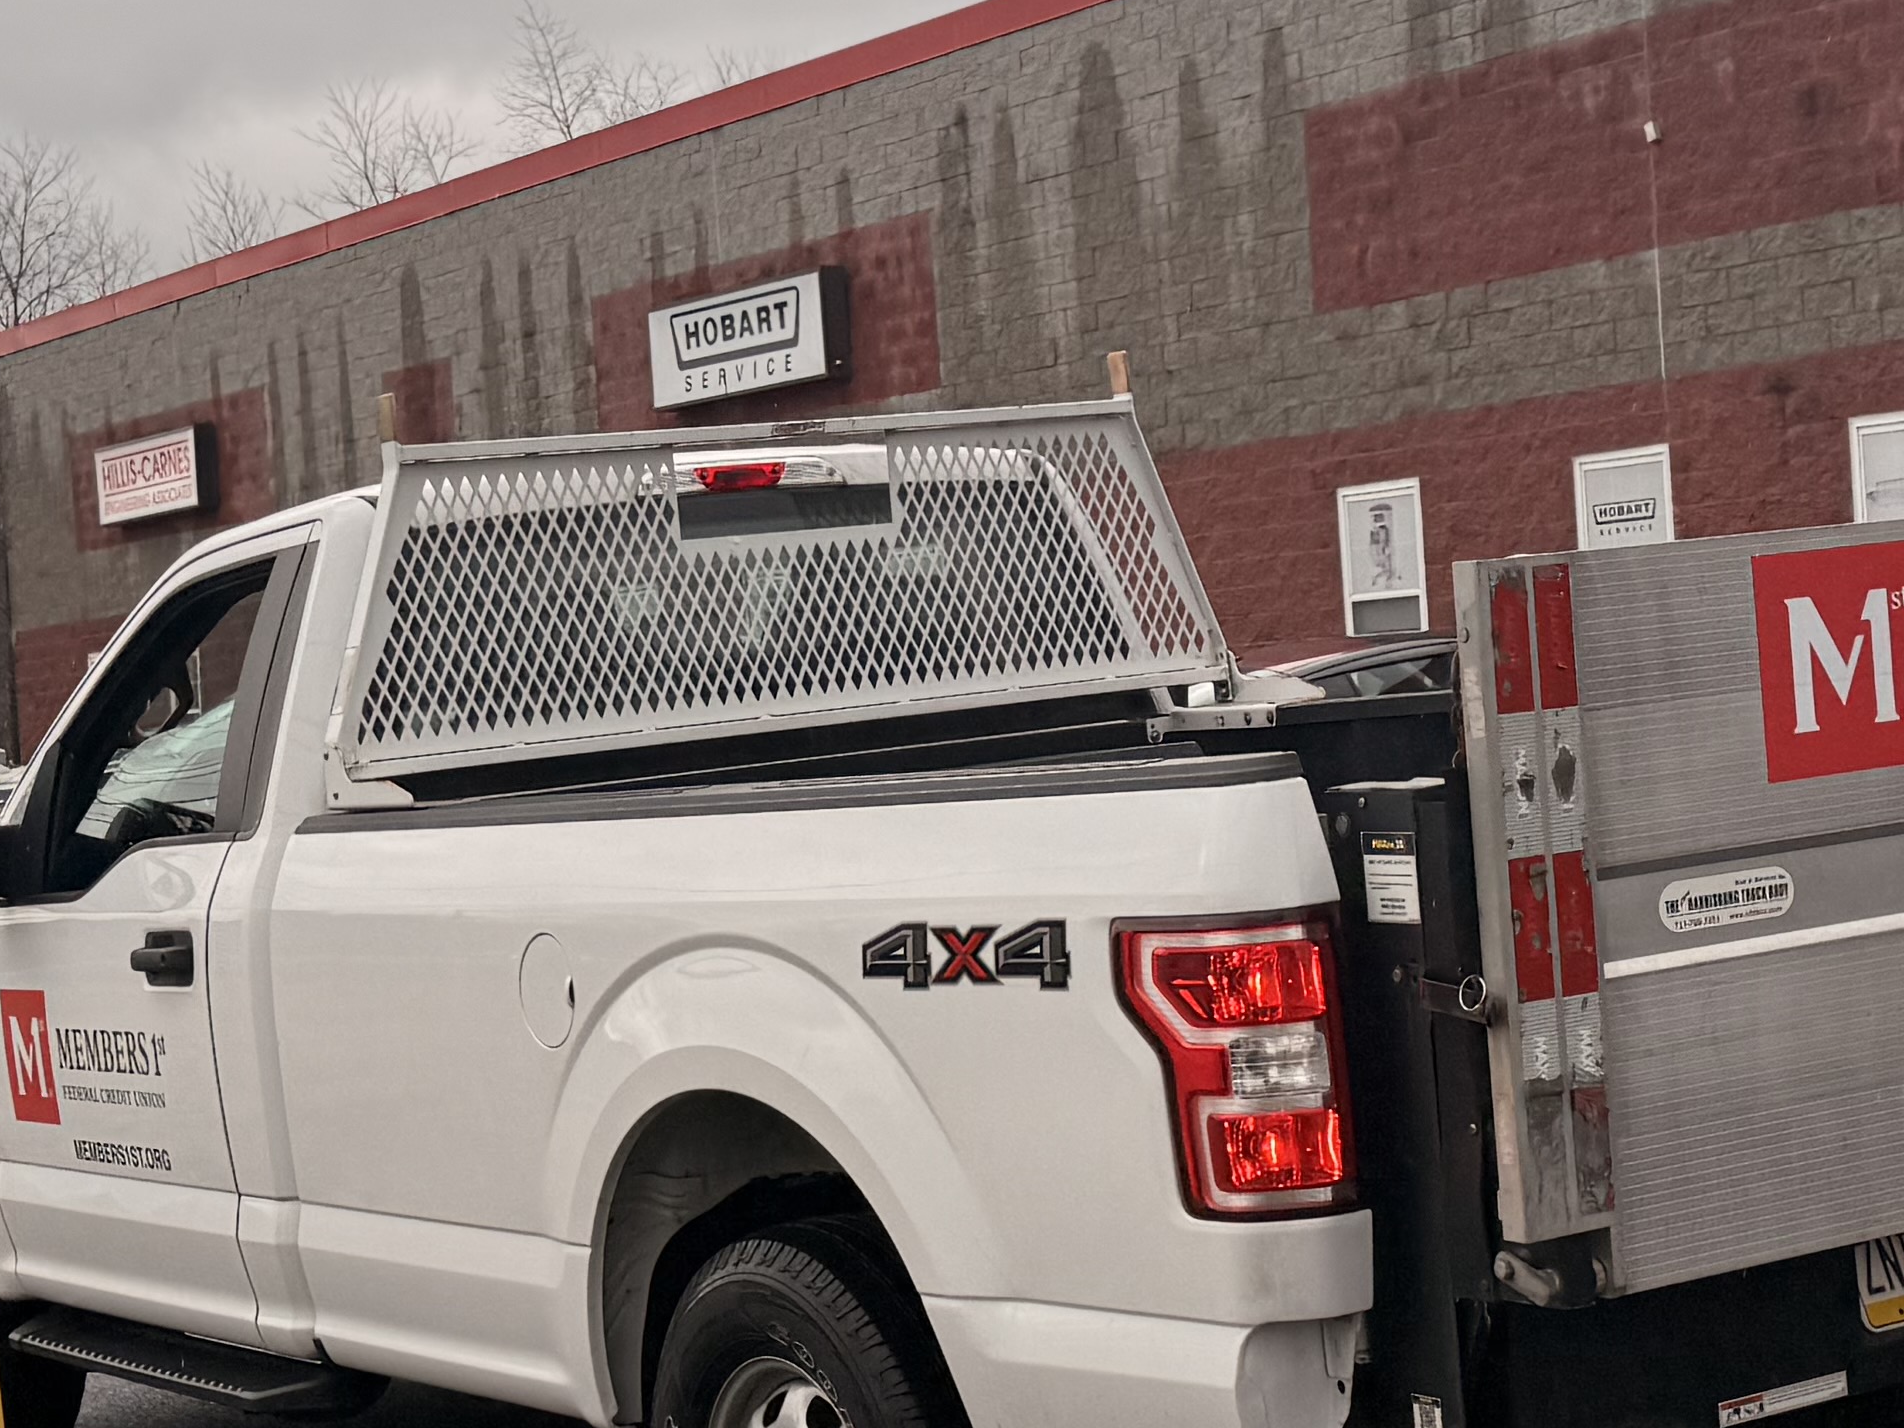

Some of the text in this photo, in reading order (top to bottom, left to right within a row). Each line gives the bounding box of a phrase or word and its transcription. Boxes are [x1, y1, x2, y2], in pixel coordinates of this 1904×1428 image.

[684, 301, 788, 350] HOBART
[684, 354, 792, 392] SERVICE
[102, 445, 191, 491] HILLIS-CARNES
[1599, 502, 1651, 518] HOBART
[55, 1027, 150, 1077] MEMBERS
[62, 1084, 166, 1109] FEDERAL CREDIT UNION
[73, 1139, 172, 1171] MEMBERS1ST.ORG
